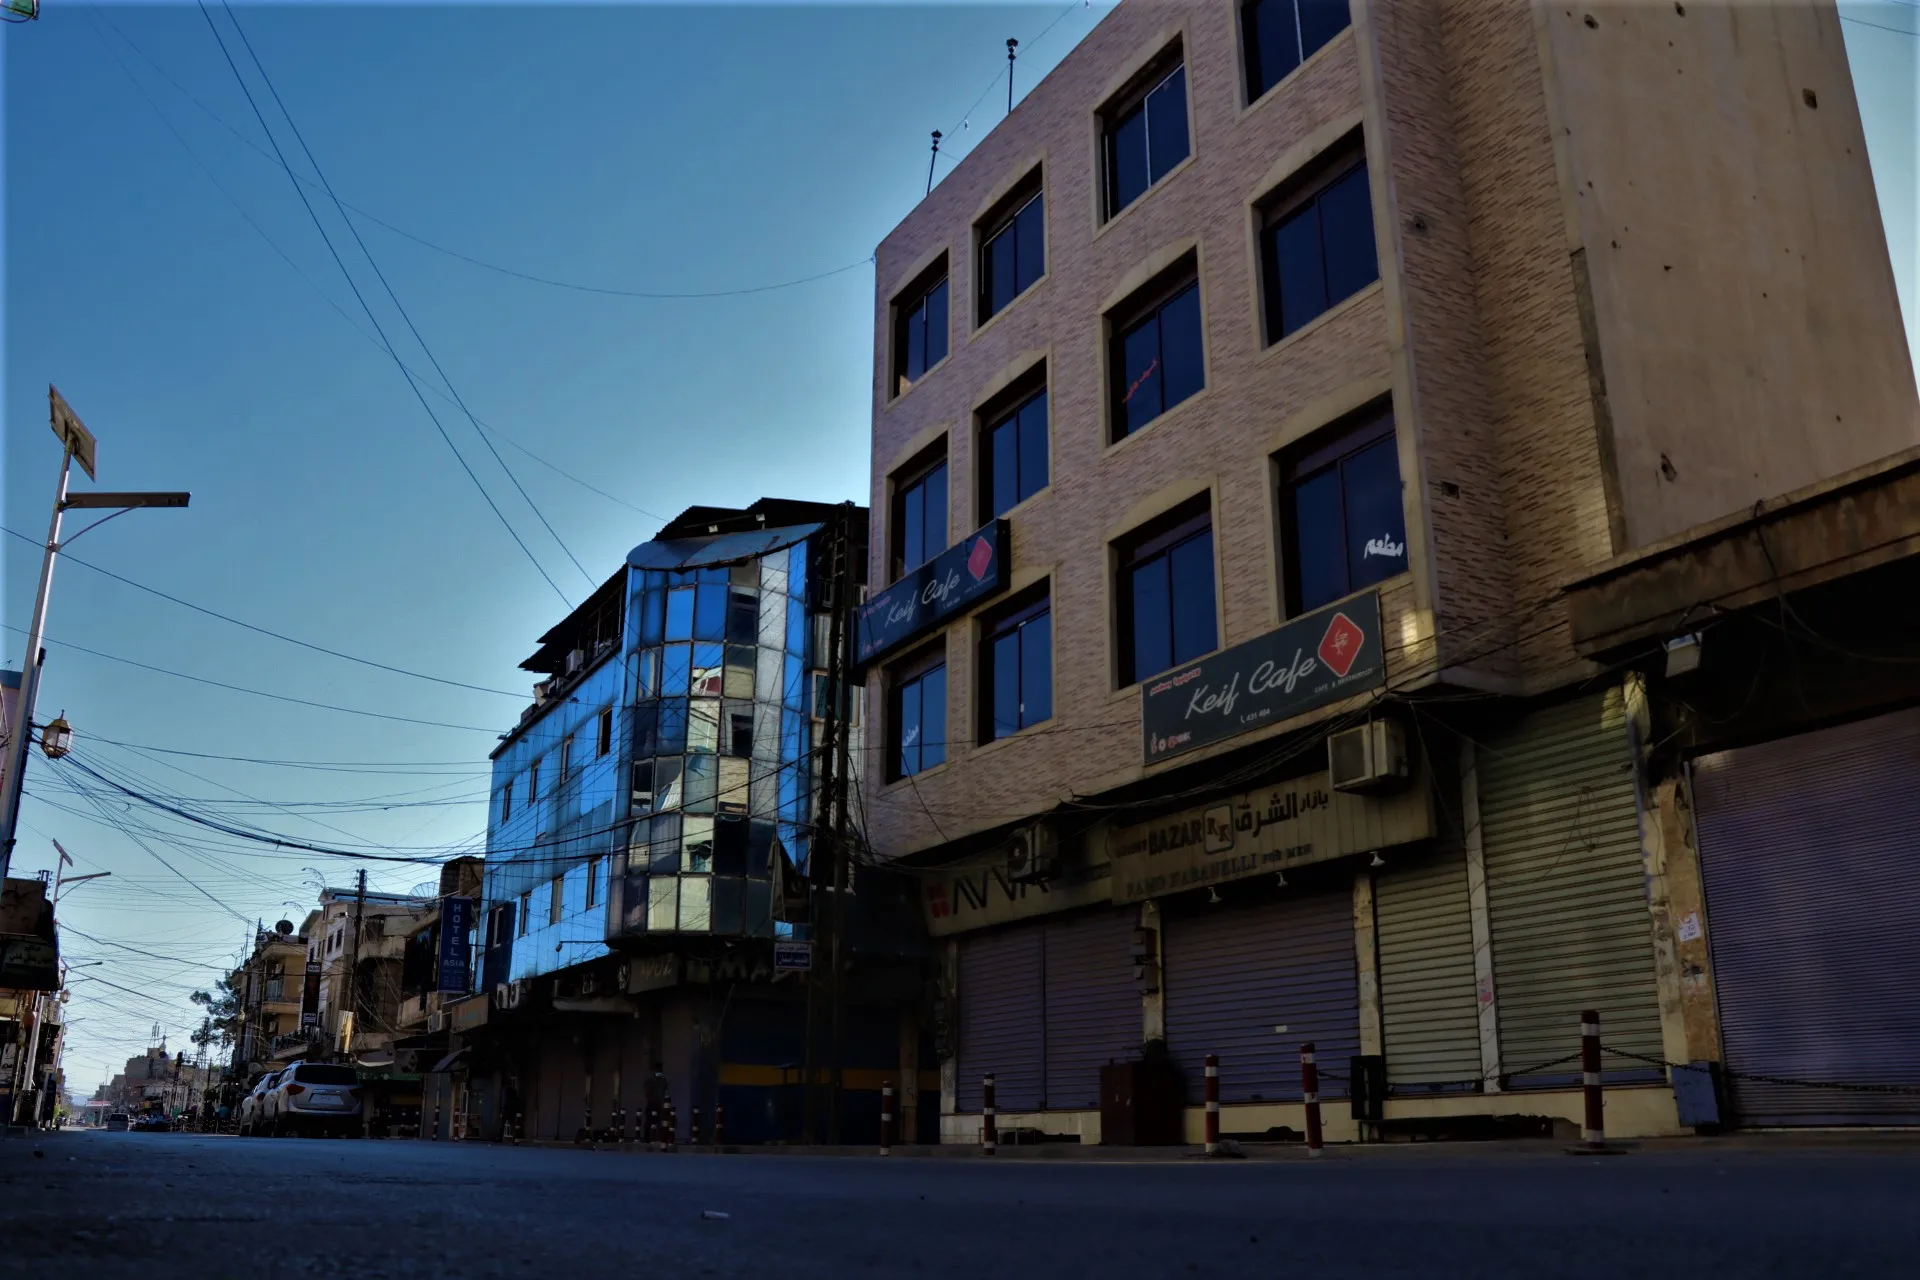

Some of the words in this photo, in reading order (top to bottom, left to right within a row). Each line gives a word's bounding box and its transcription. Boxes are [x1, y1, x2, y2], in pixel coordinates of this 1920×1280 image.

[884, 590, 918, 629] Keif
[921, 568, 961, 605] Cafe
[1185, 672, 1240, 720] Keif
[1248, 648, 1318, 694] Cafe
[1235, 791, 1298, 838] الشرق
[1300, 790, 1328, 812] بازار
[1148, 820, 1202, 855] BAZAR
[450, 903, 462, 957] HOTEL
[443, 959, 465, 968] ASIA
